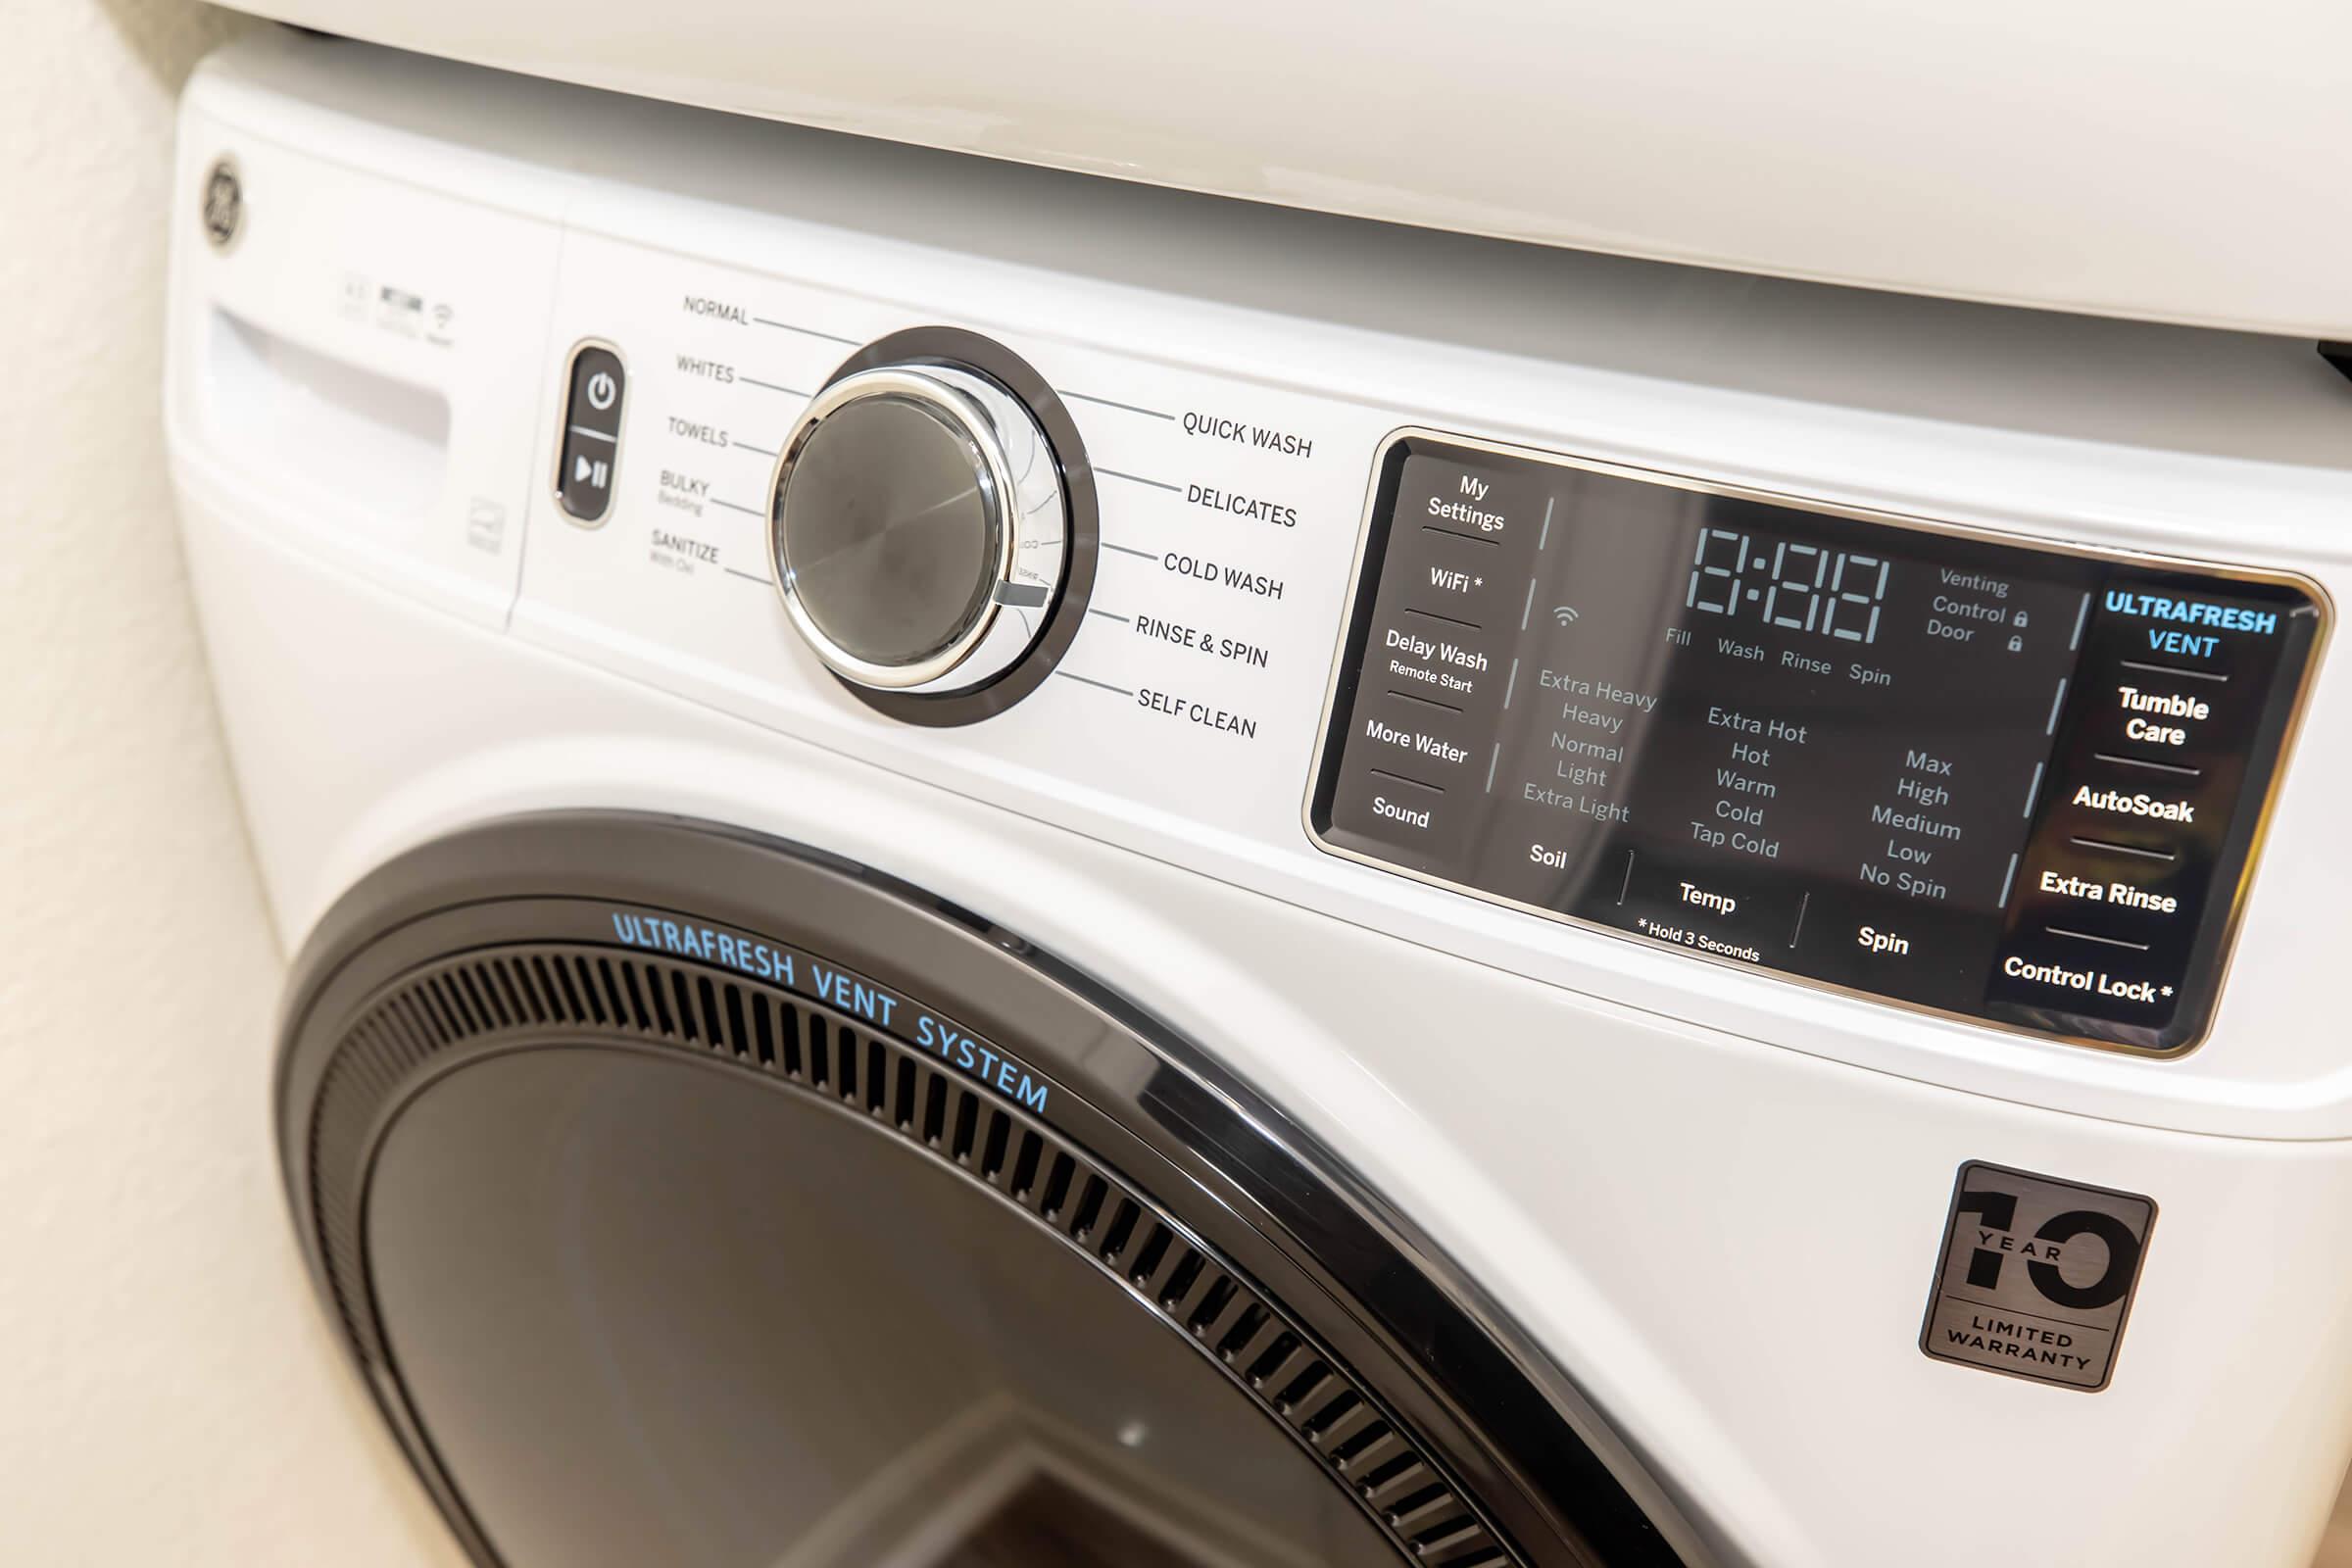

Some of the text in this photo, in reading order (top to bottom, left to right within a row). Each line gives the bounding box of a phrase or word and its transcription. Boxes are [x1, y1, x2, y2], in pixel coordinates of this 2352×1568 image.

[683, 296, 749, 325] NORMAL
[676, 355, 734, 383] WHITES
[668, 416, 728, 448] TOWELS
[1183, 412, 1312, 458] QUICK WASH
[661, 469, 710, 497] BULKY
[1459, 475, 1489, 501] My
[1187, 484, 1297, 527] DELICATES
[1427, 497, 1505, 532] Settings
[652, 529, 719, 564] SANITIZE
[1164, 553, 1284, 600] COLD WASH
[1430, 566, 1469, 593] WiFi
[1940, 567, 2009, 599] Venting
[1933, 596, 2006, 623] Control
[2104, 590, 2277, 635] ULTRAFRESH
[1136, 614, 1269, 668] RINSE & SPIN
[1927, 618, 1975, 643] Door
[2148, 629, 2220, 659] VENT
[1386, 628, 1488, 672] Delay Wash
[1666, 627, 1891, 686] Fill Wash Rinse Spin
[1390, 660, 1473, 693] Remote Start
[1540, 669, 1658, 712] Extra Heavy
[1138, 688, 1257, 739] SELF CLEAN
[1562, 703, 1623, 733] Heavy
[2118, 686, 2210, 721] Tumble
[1365, 719, 1468, 763] More Water
[1707, 707, 1808, 744] Extra Hot
[2126, 717, 2186, 747] Care
[1551, 731, 1623, 762] Normal
[1731, 742, 1770, 767] Hot
[1905, 750, 1953, 776] Max
[1556, 760, 1607, 787] Light
[1716, 767, 1777, 798] Warm
[1524, 783, 1631, 823] Extra Light
[1896, 778, 1949, 806] High
[2072, 785, 2195, 823] AutoSoak
[1372, 796, 1430, 828] Sound
[1715, 800, 1763, 826] Cold
[1871, 805, 1961, 840] Medium
[1690, 821, 1780, 858] Tap Cold
[1887, 839, 1932, 864] Low
[1530, 844, 1567, 869] Soil
[1859, 863, 1947, 900] No Spin
[2039, 870, 2178, 913] Extra Rinse
[1680, 882, 1736, 915] Temp
[1648, 921, 1760, 962] Hold 3 Seconds
[1857, 926, 1910, 956] Spin
[2003, 956, 2156, 1004] Control Lock
[612, 913, 1049, 1114] ULTRAFRESH VENT SYSTEM
[1959, 1191, 2142, 1310] 10
[1978, 1230, 2062, 1261] YEAR
[1972, 1315, 2073, 1348] LIMITED
[1946, 1329, 2092, 1371] WARRANTY
